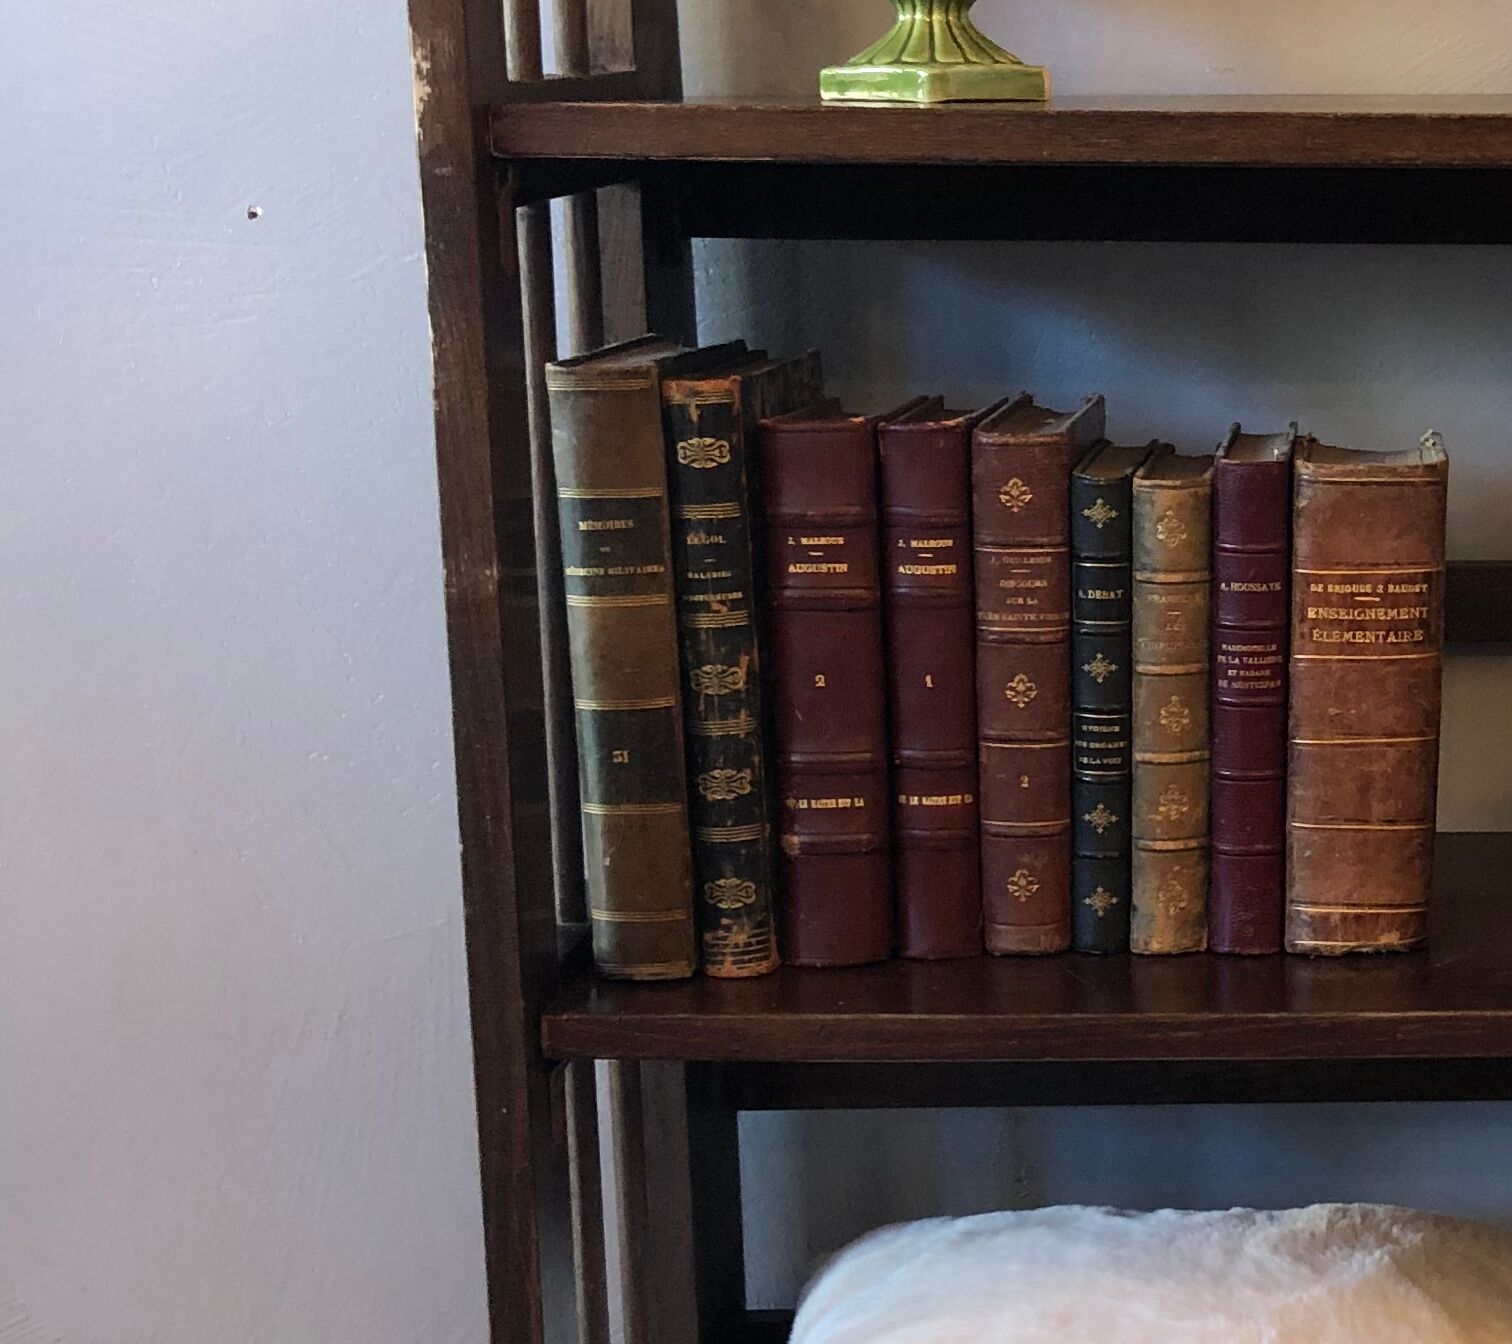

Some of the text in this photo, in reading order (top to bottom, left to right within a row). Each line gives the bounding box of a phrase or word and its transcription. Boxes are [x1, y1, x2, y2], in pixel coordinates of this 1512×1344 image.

[788, 562, 849, 574] AUGUSTIN
[898, 564, 957, 575] AUGUSTIN
[1306, 606, 1430, 621] ENSEIGNEMENT
[815, 673, 826, 688] 2
[924, 674, 934, 688] 1
